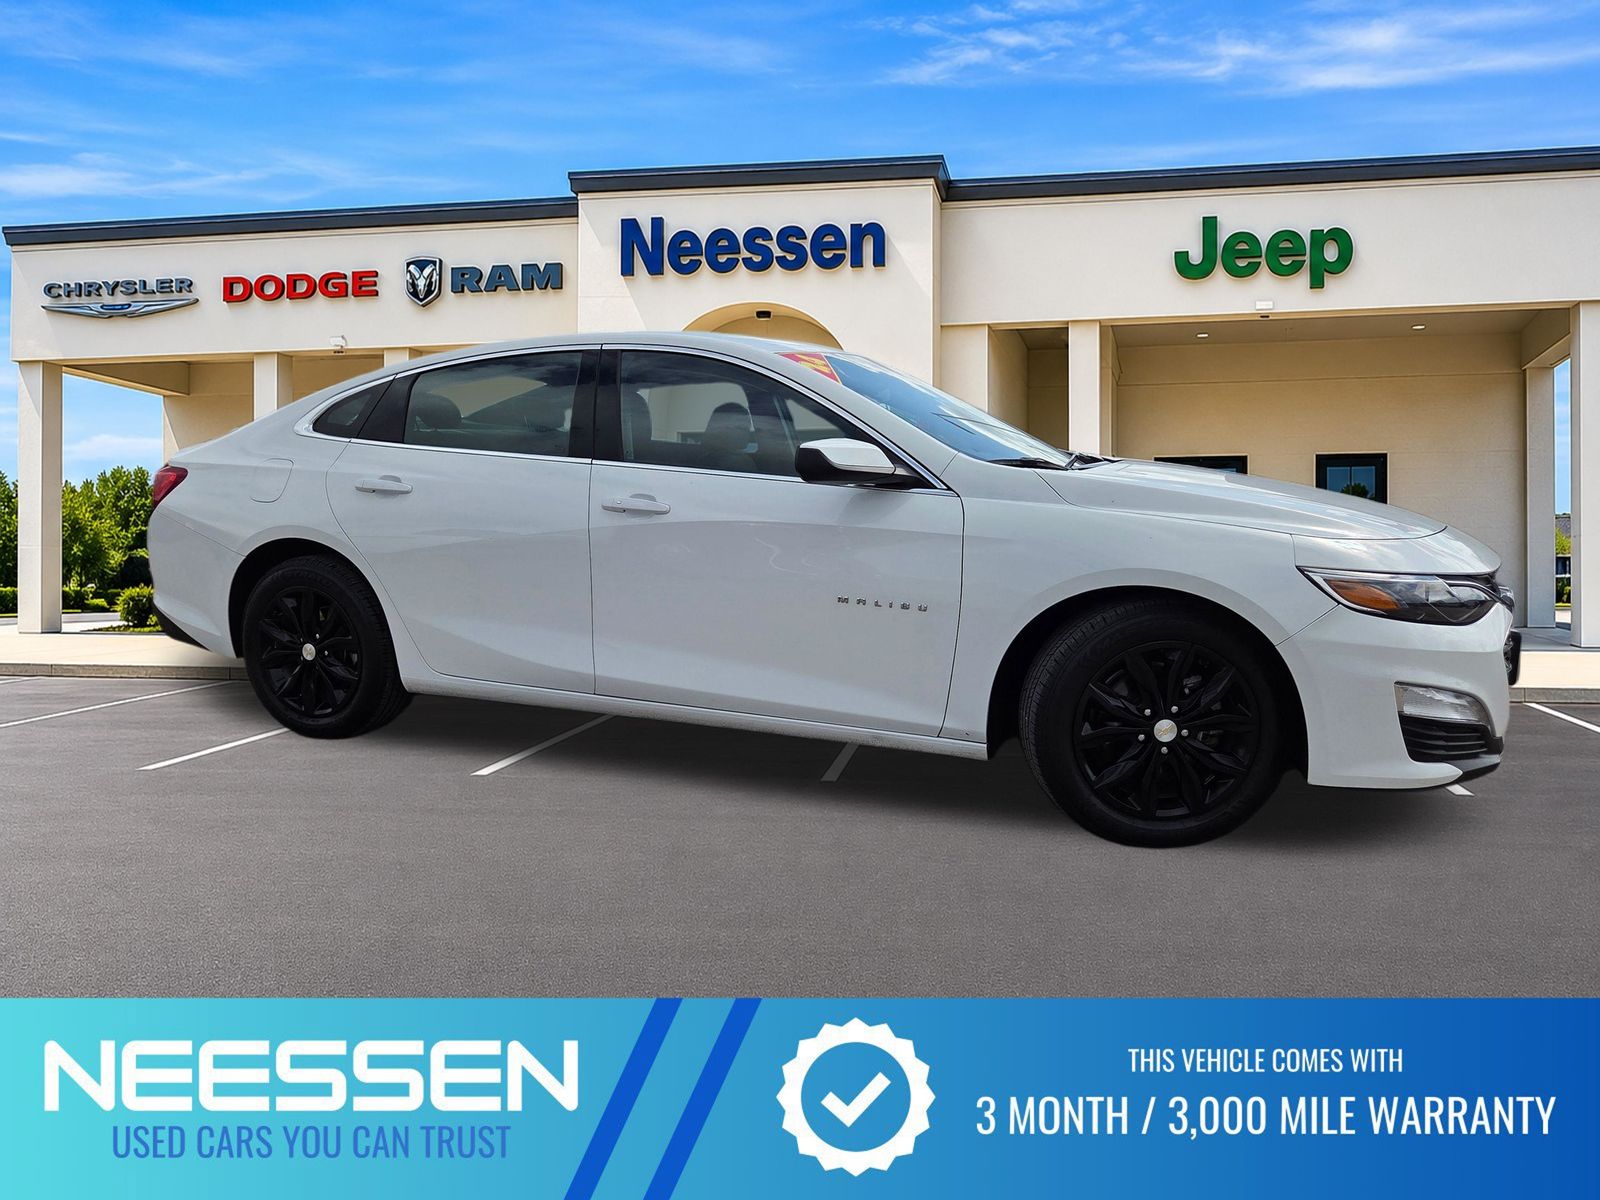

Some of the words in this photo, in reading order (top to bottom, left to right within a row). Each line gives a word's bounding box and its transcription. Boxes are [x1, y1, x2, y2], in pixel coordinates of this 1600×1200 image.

[620, 216, 887, 277] Neessen
[1173, 215, 1354, 289] Jeep
[43, 277, 194, 299] CHRYSLER
[222, 270, 379, 303] DODGE
[450, 262, 564, 294] RAM
[837, 596, 928, 612] MALIBU
